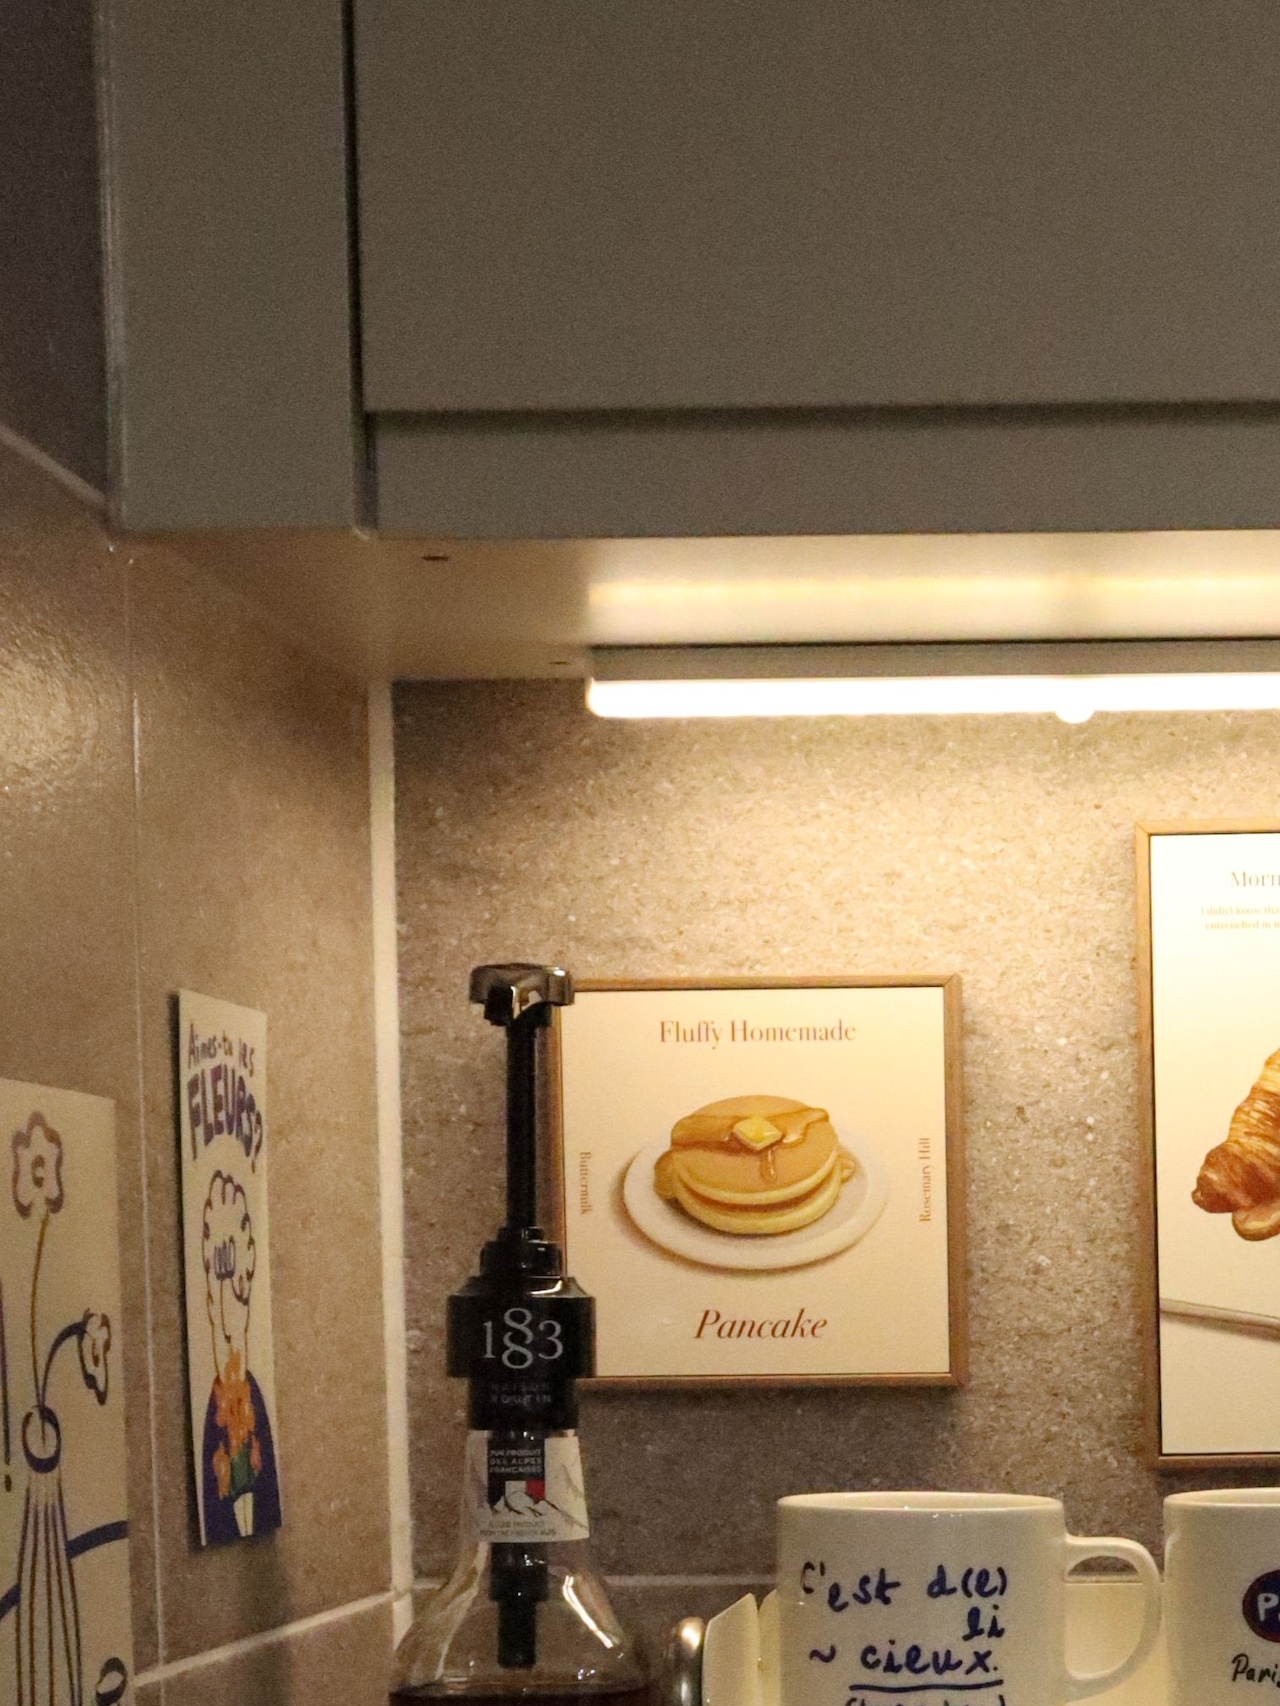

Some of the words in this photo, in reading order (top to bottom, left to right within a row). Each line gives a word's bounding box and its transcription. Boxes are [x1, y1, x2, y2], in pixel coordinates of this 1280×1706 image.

[1205, 919, 1259, 930] entrenched
[1261, 919, 1272, 929] in
[1235, 905, 1261, 915] know
[659, 1020, 722, 1049] Fluffy
[730, 1018, 857, 1043] Homemade
[918, 1136, 931, 1160] Hill
[579, 1151, 593, 1215] Buttermilk
[918, 1165, 935, 1223] Rosemary
[693, 1308, 828, 1340] Pancake
[800, 1561, 902, 1612] C'est
[926, 1563, 1008, 1599] d(e)
